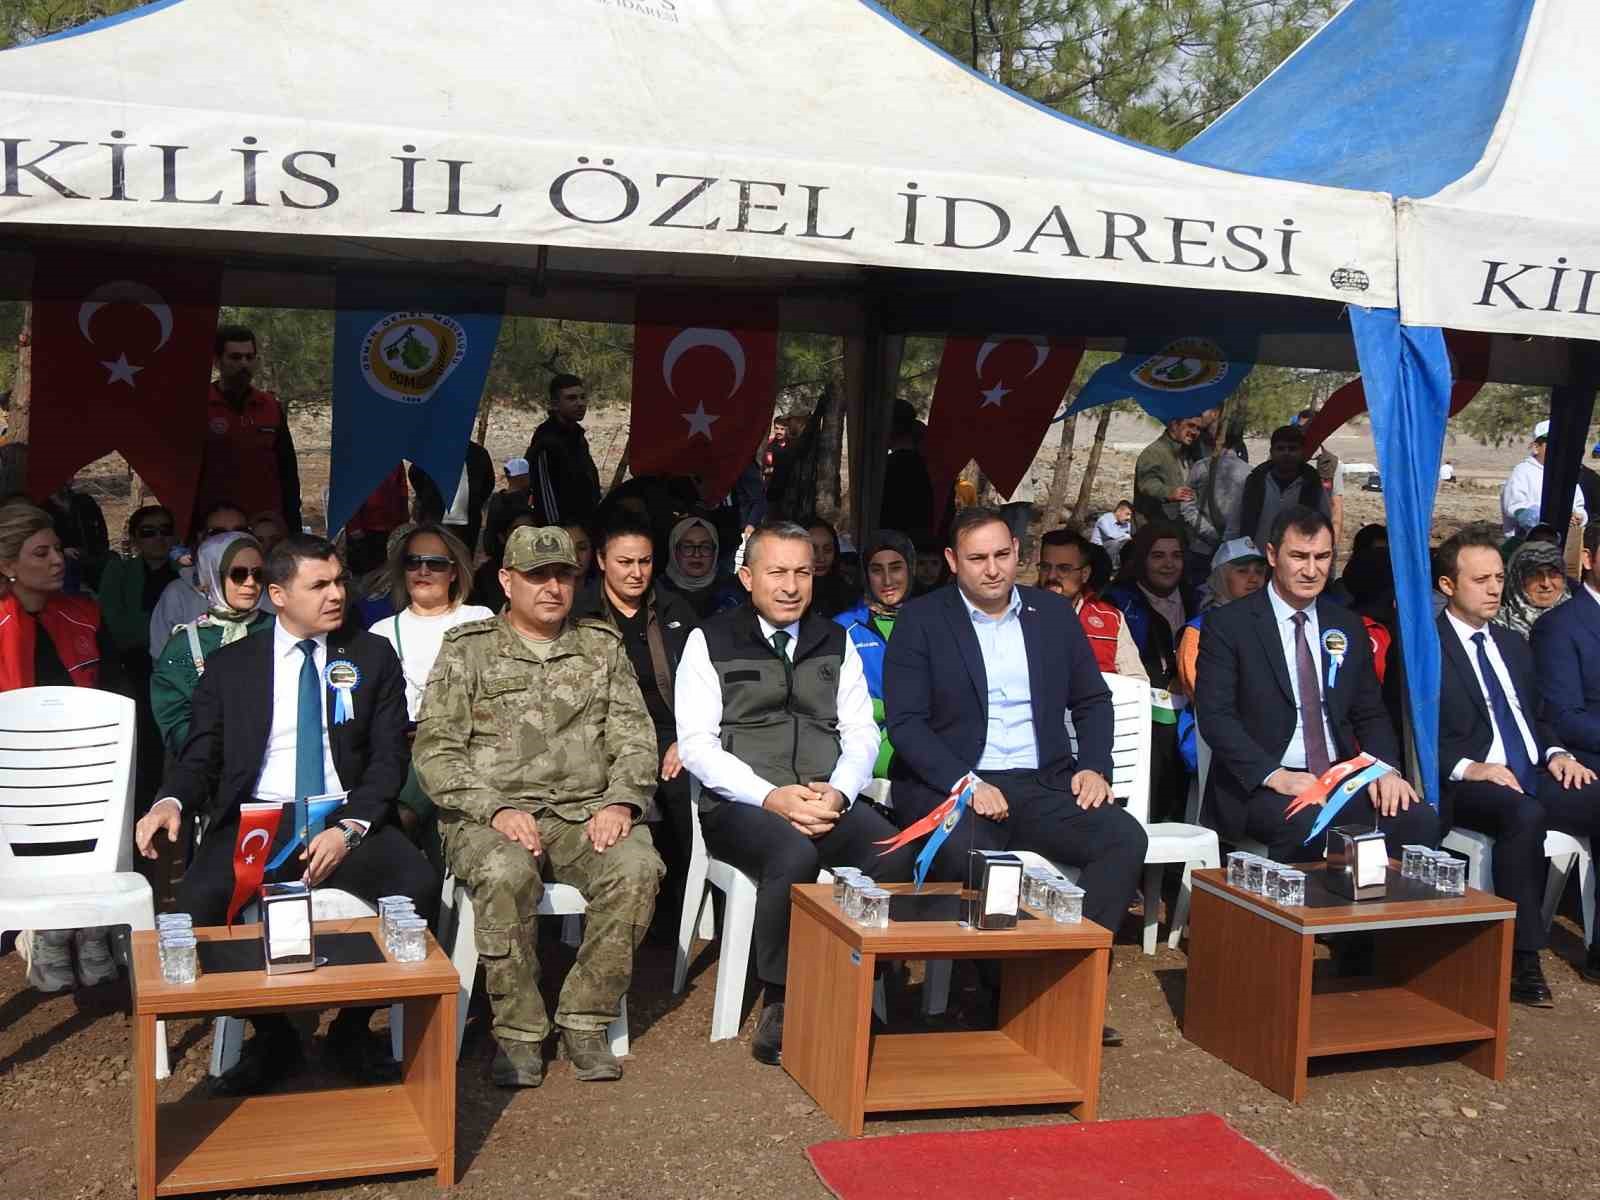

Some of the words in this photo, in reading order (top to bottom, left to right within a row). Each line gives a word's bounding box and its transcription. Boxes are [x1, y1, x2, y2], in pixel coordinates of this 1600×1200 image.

[0, 130, 340, 209] KİLİS
[390, 144, 502, 218] İL
[548, 156, 855, 241] ÖZEL
[894, 182, 1302, 276] İDARESİ
